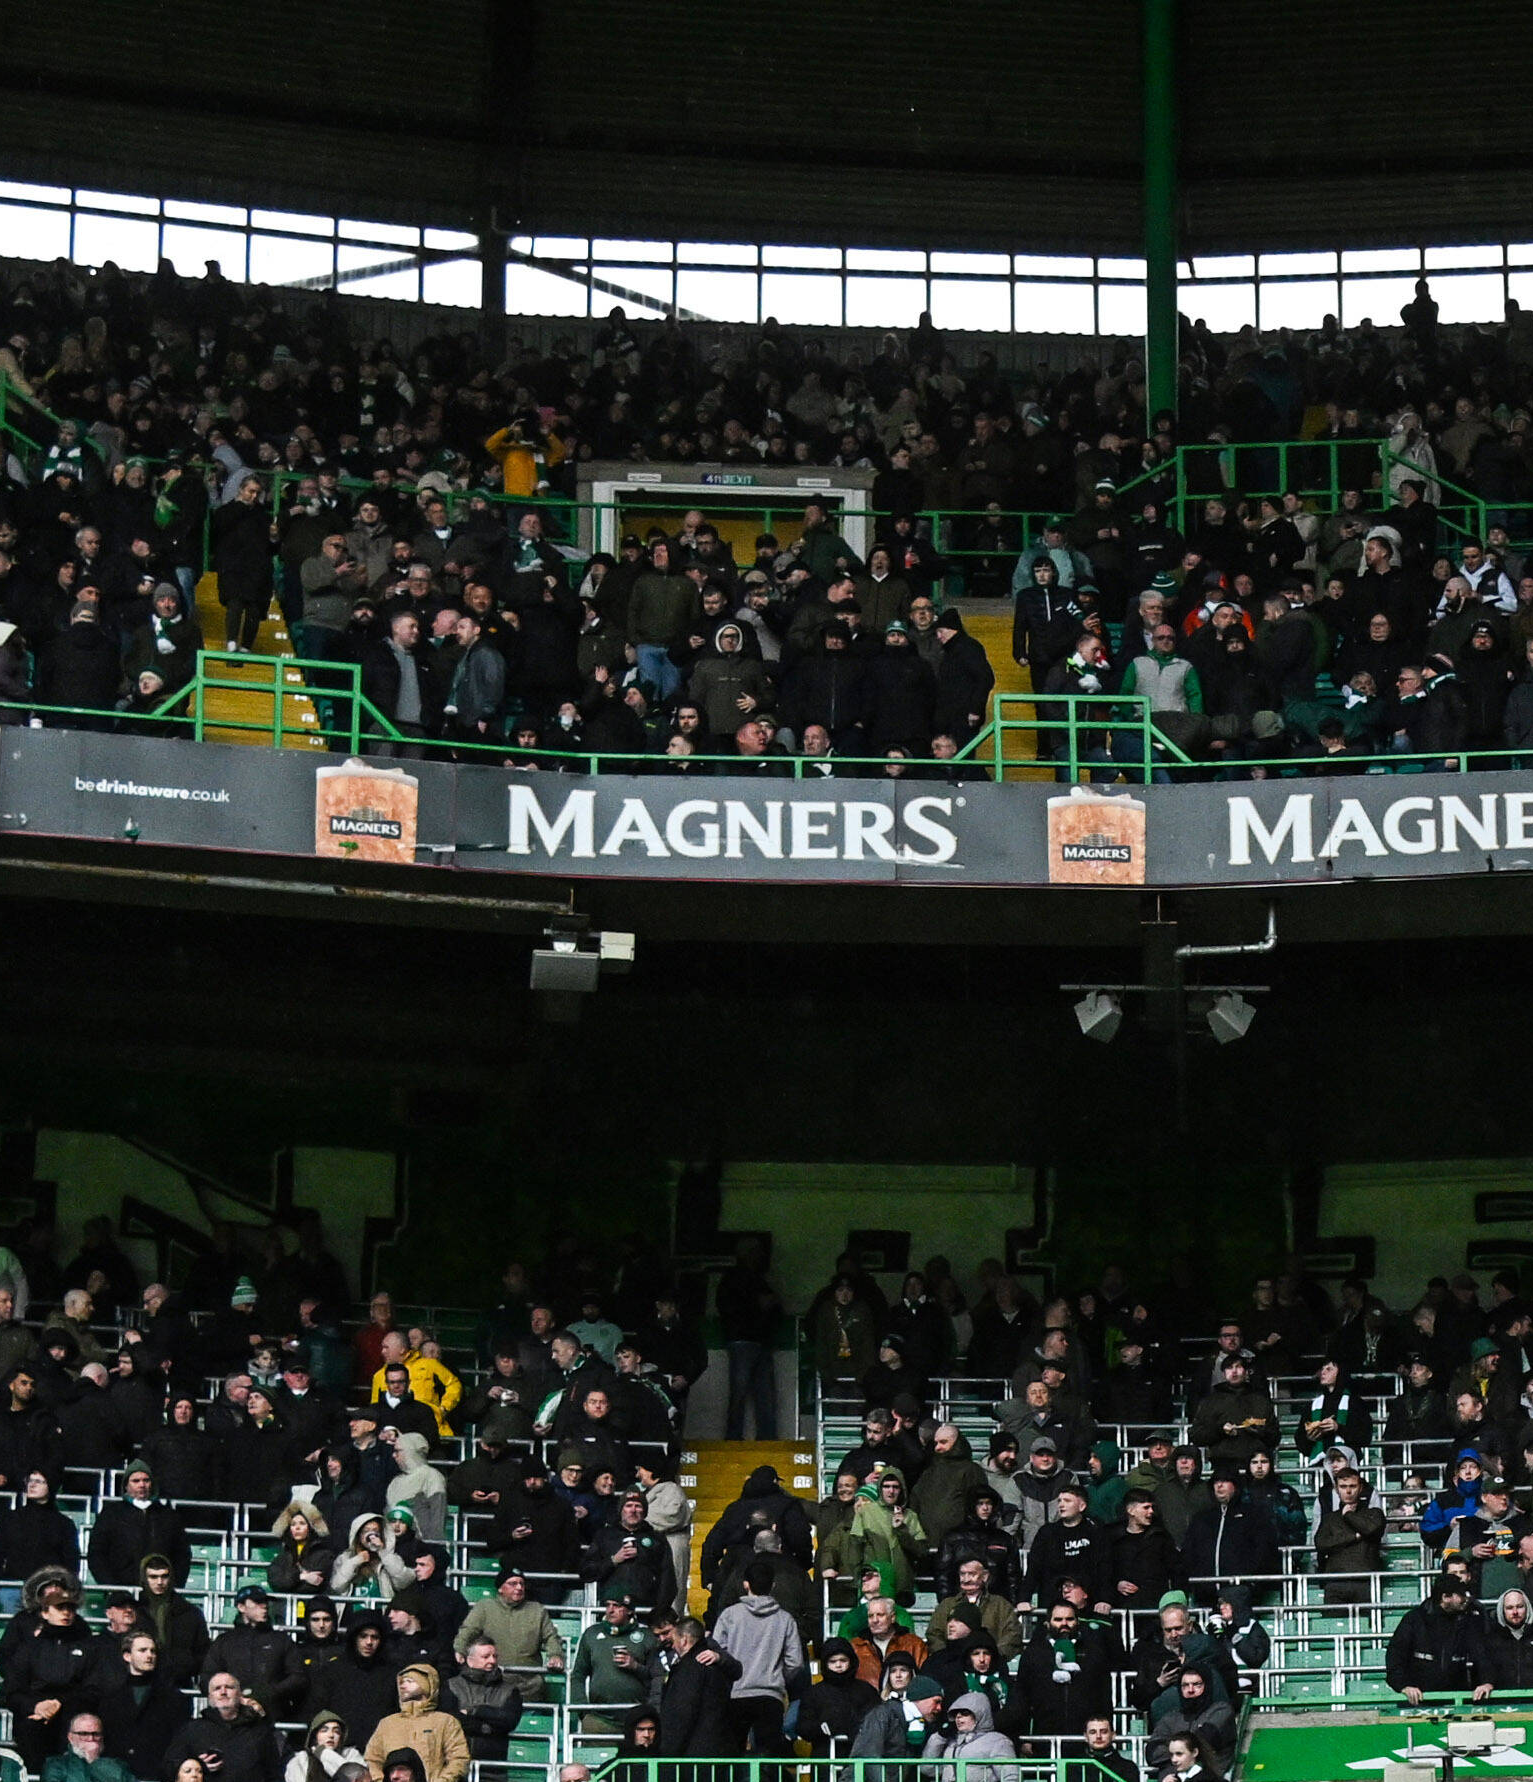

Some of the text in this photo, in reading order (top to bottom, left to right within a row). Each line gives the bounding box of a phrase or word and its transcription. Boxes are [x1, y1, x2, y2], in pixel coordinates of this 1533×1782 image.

[74, 774, 230, 804] bedrinkaware.co.uk
[332, 818, 399, 836] MAGNERS
[507, 784, 958, 862] MAGNERS
[1064, 847, 1129, 860] MAGNERS
